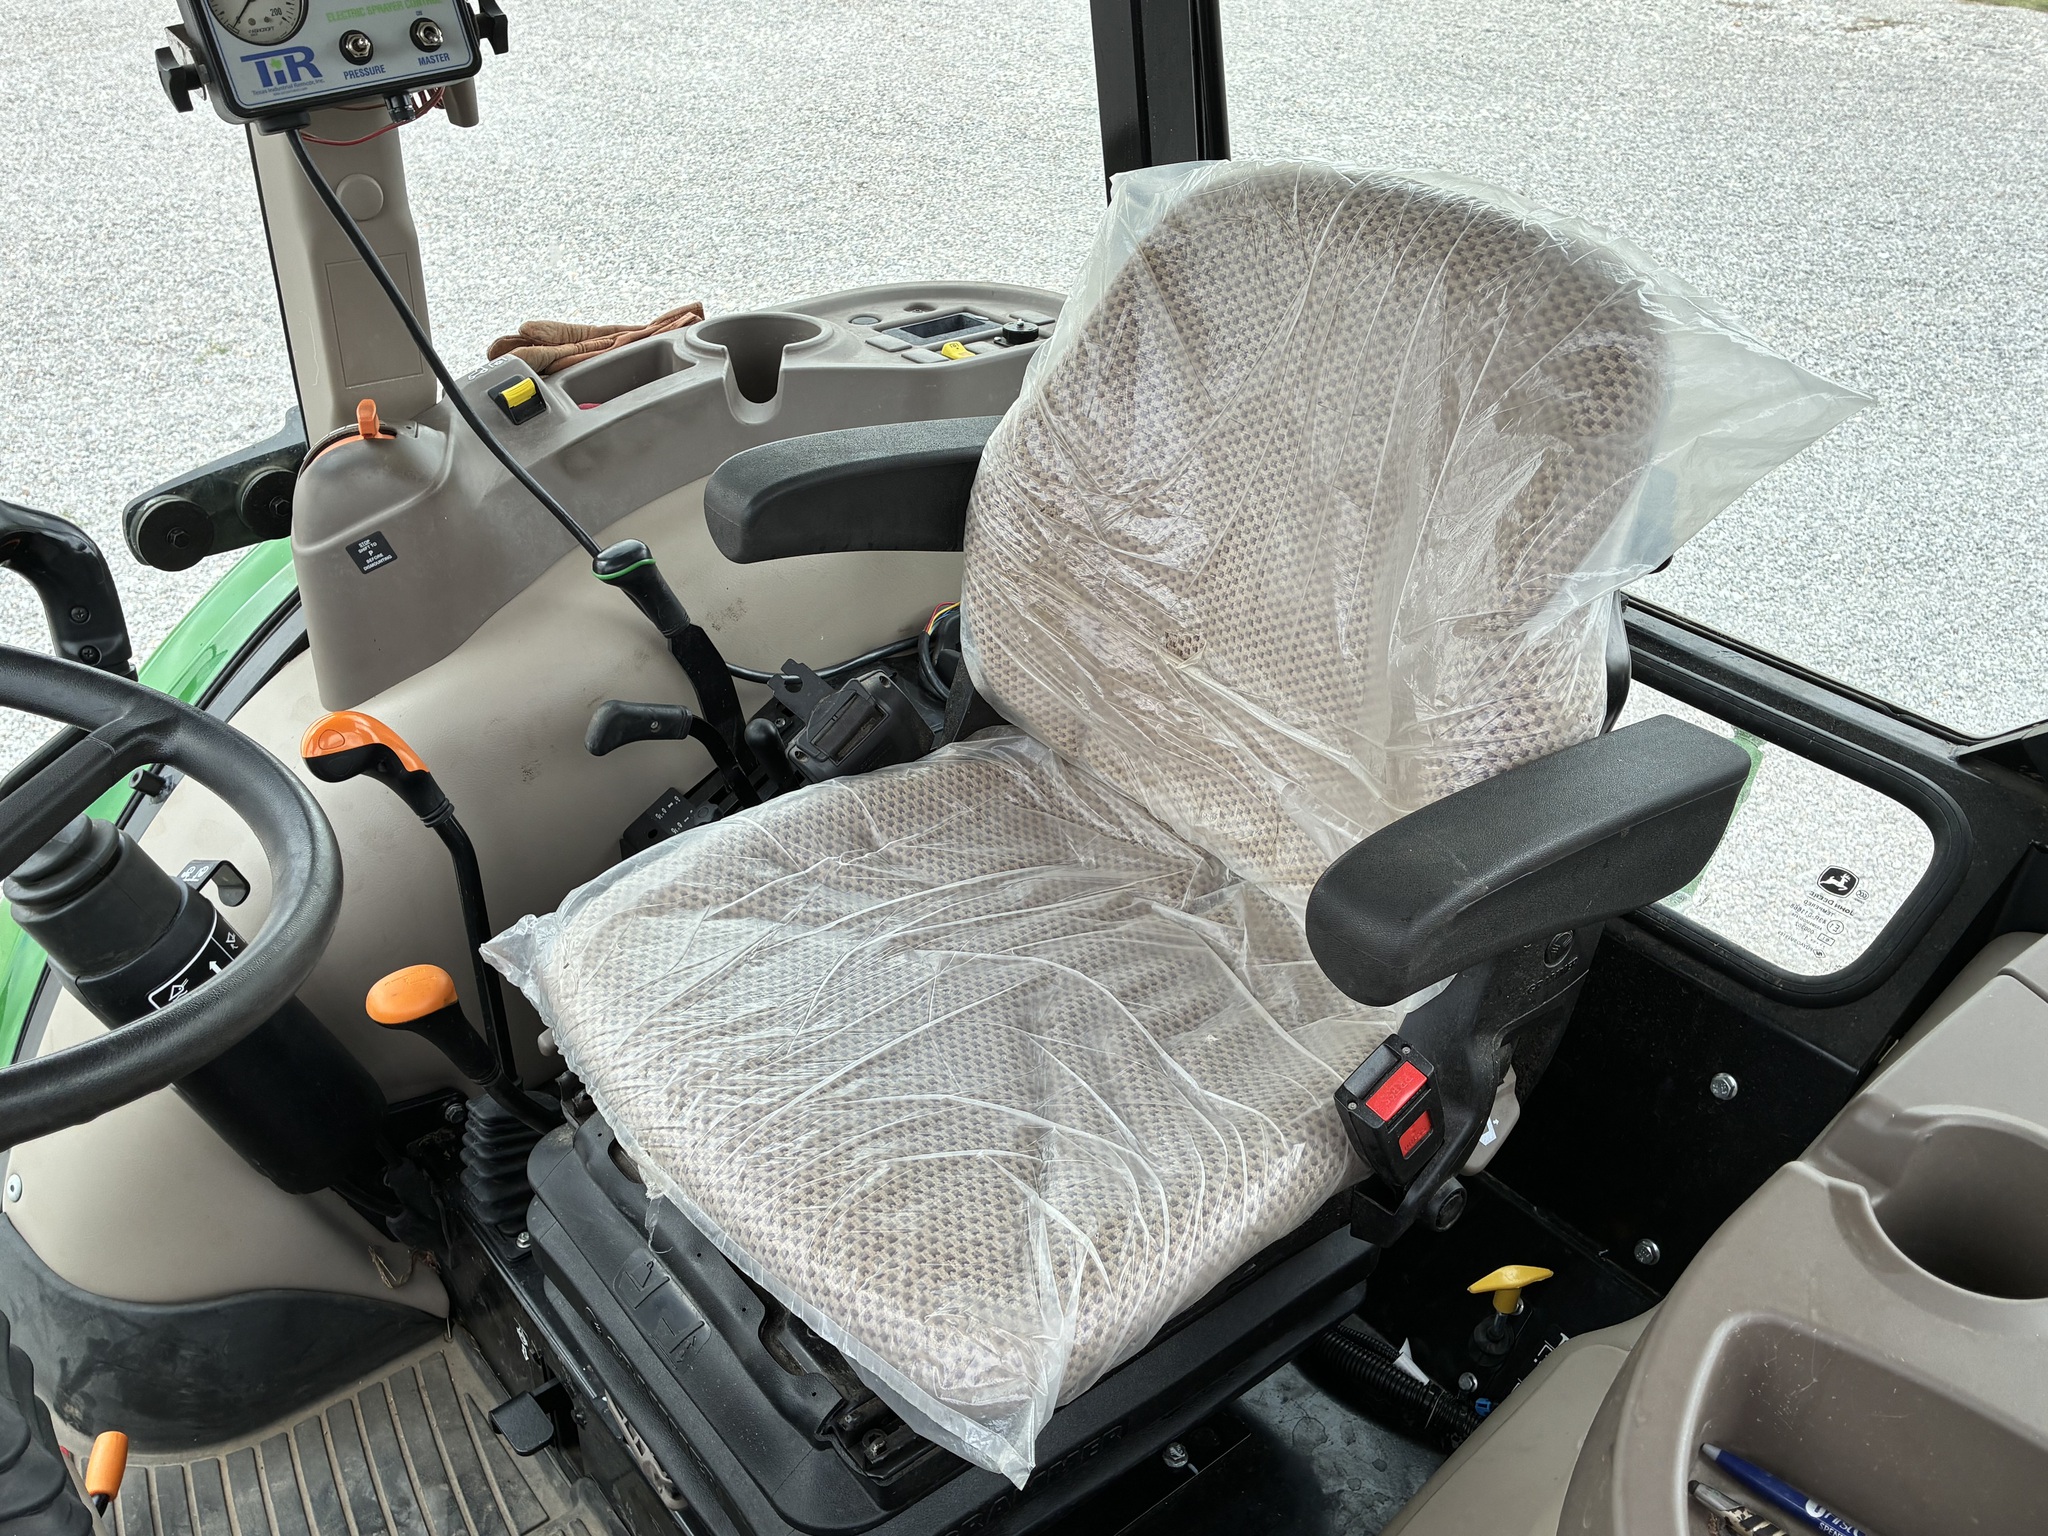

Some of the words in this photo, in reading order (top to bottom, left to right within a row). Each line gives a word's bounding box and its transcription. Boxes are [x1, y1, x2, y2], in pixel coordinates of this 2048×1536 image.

[269, 7, 283, 17] 200
[326, 7, 366, 22] ELECTRIC
[367, 2, 404, 16] SPRAYER
[418, 52, 451, 66] MASTER
[343, 64, 386, 80] PRESSURE
[267, 84, 293, 93] Industrial
[358, 545, 370, 553] SHIFT
[366, 553, 384, 564] BEFORE
